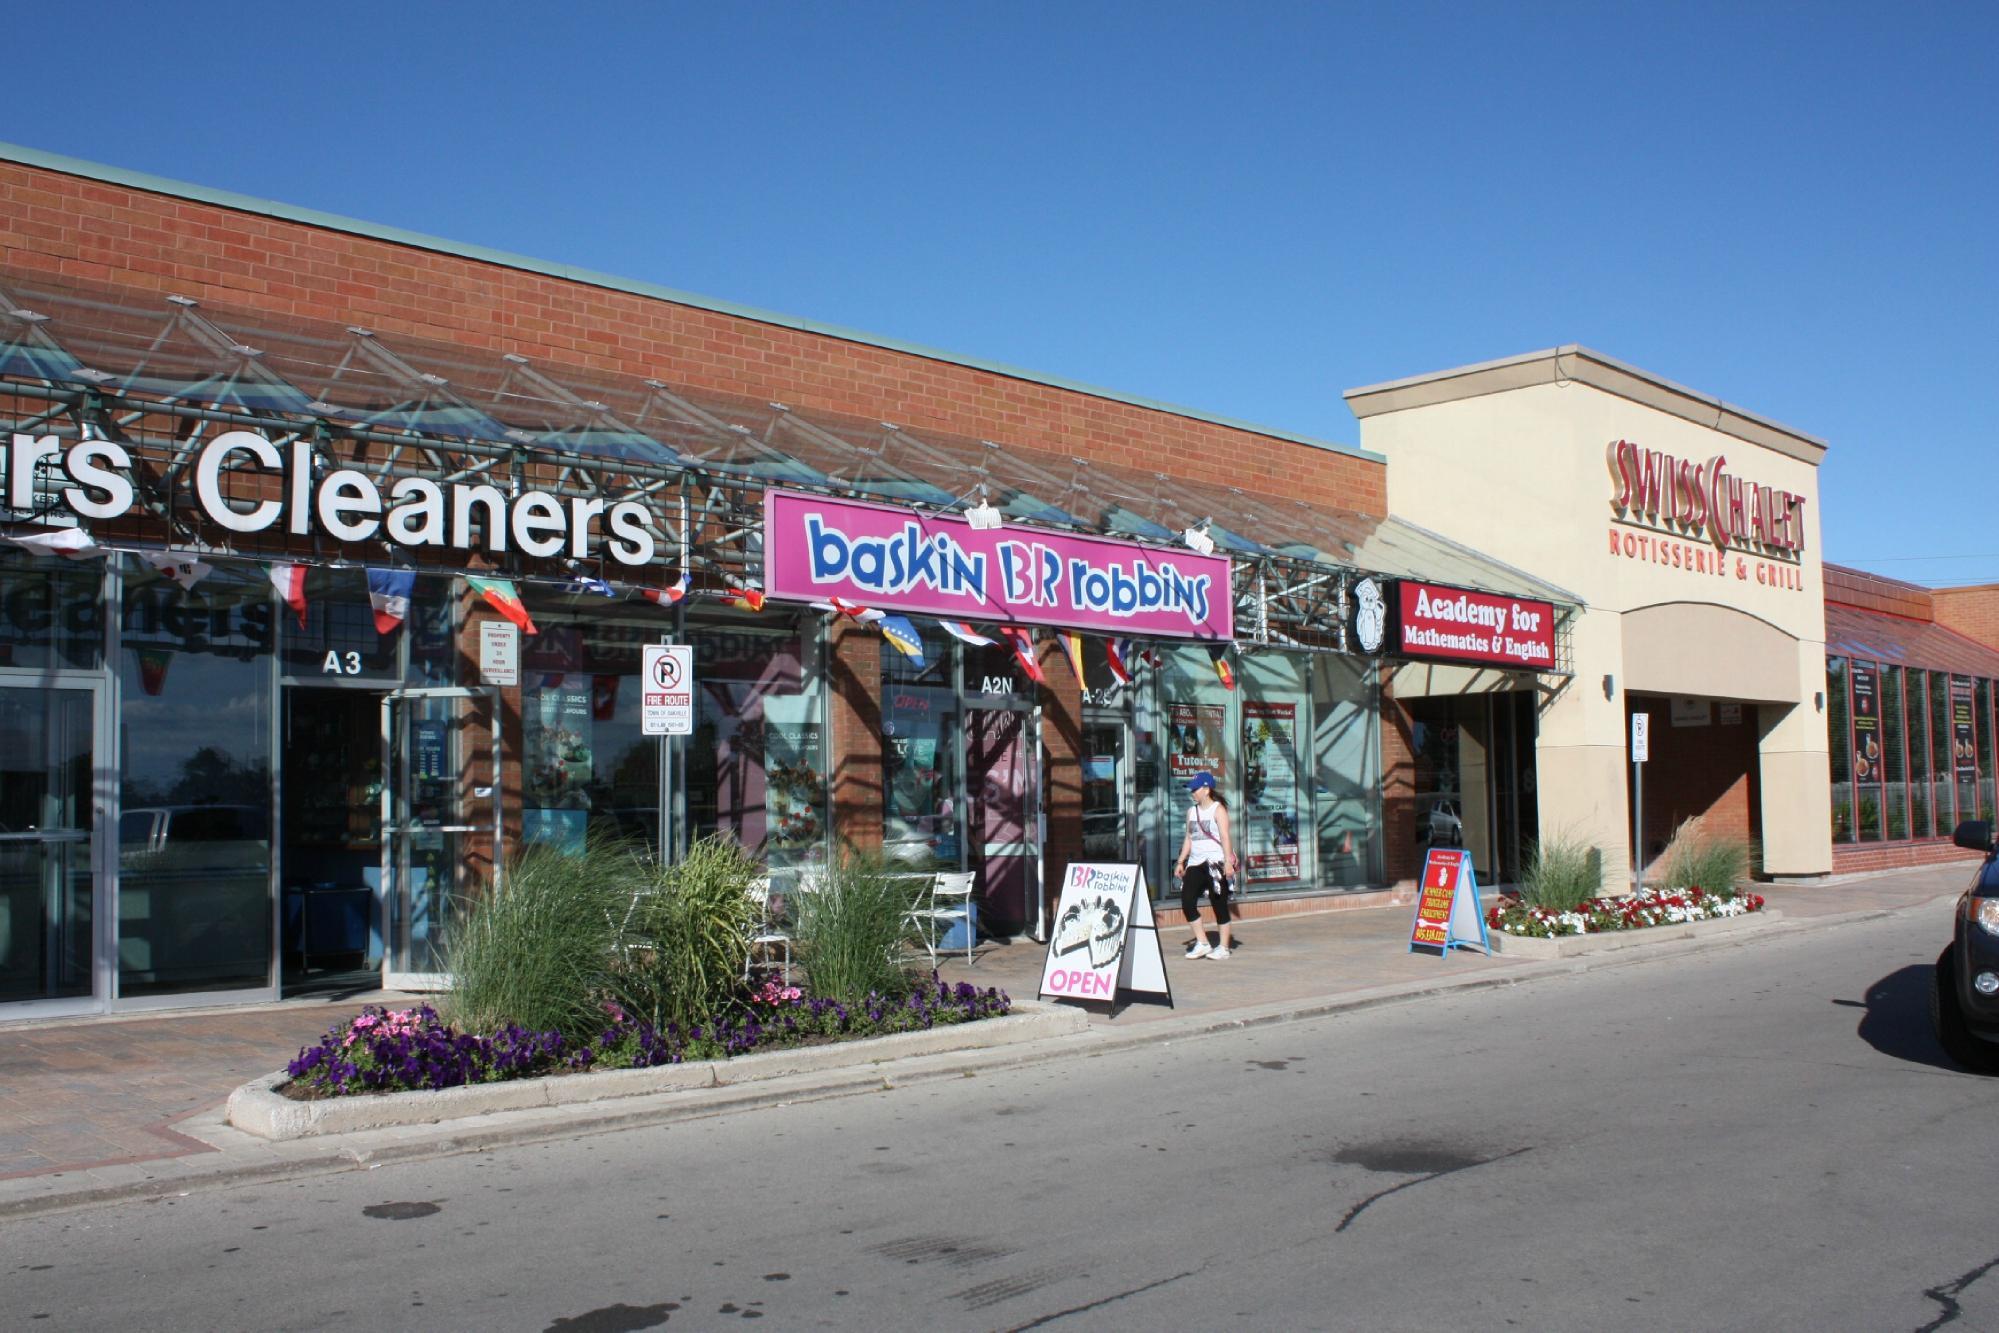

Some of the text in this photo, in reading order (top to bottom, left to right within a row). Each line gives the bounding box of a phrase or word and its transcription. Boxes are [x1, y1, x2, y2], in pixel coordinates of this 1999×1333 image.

[197, 431, 654, 565] Cleaners
[1607, 439, 1806, 551] SWISS CHALET
[805, 515, 1211, 624] baskin BR robbins
[1608, 528, 1803, 591] ROTISSERIE & GRILL
[1415, 588, 1540, 634] Academy for
[1405, 625, 1549, 660] Mathematics & English
[322, 651, 361, 675] A3
[981, 676, 1013, 694] A2N
[646, 695, 689, 706] FIRE ROUTE
[1177, 754, 1219, 769] Tutoring
[1070, 866, 1097, 889] BR
[1094, 881, 1128, 893] robbins
[1096, 869, 1129, 882] baskin
[1049, 969, 1111, 995] OPEN
